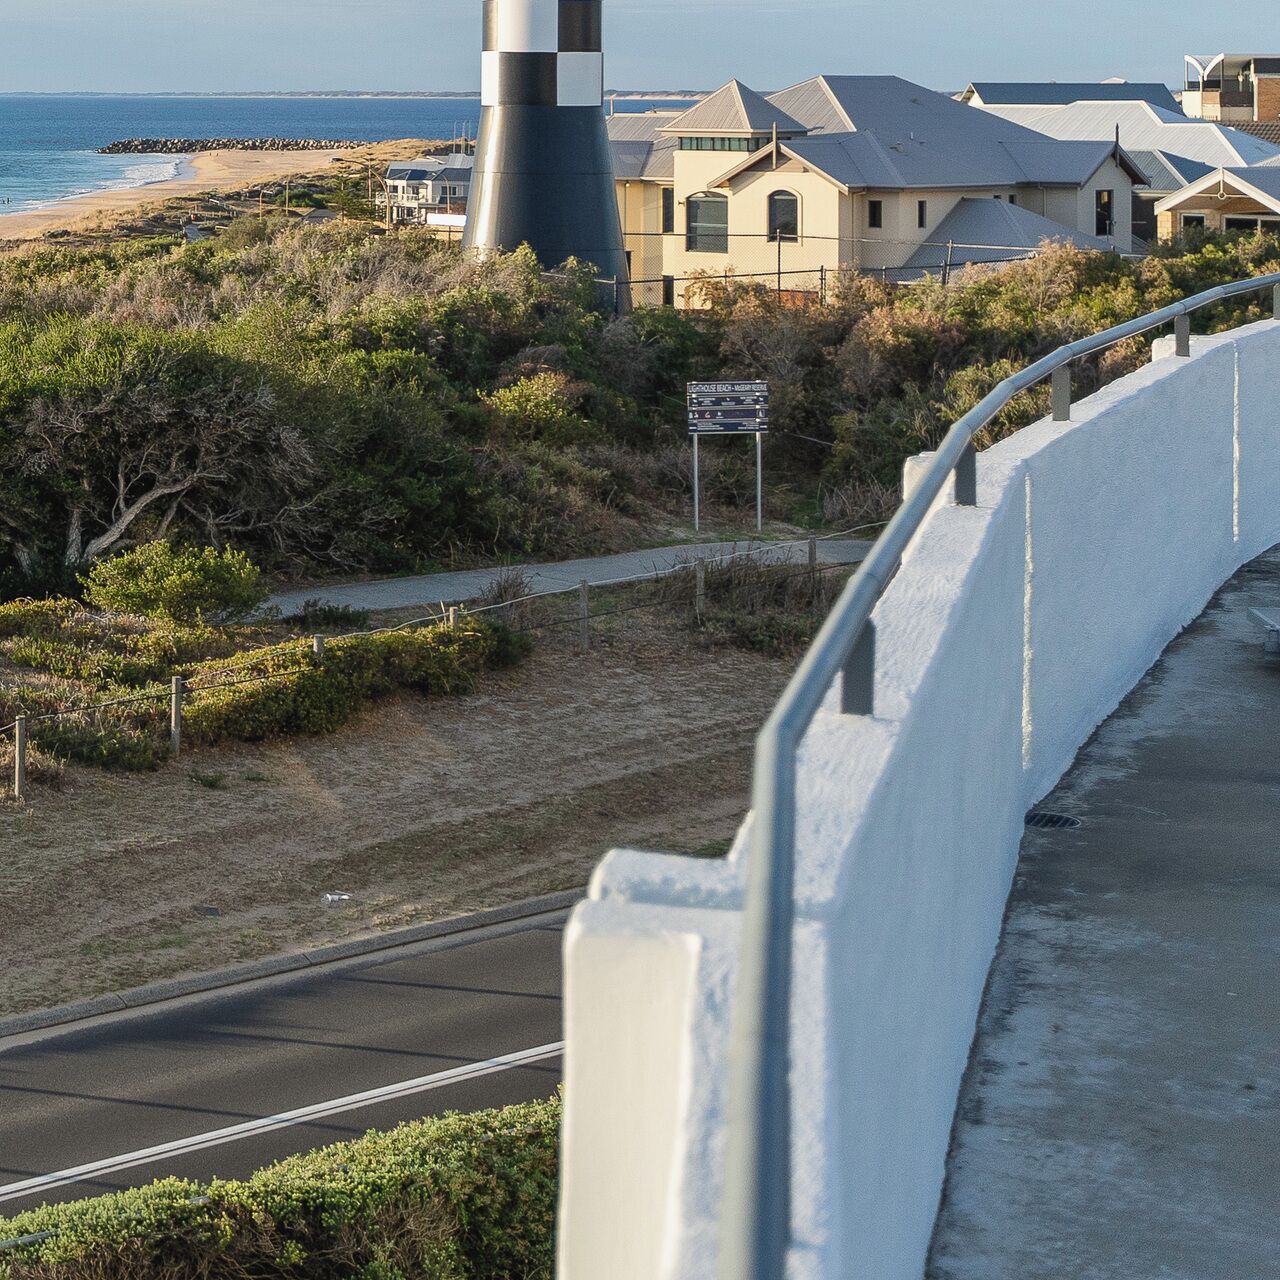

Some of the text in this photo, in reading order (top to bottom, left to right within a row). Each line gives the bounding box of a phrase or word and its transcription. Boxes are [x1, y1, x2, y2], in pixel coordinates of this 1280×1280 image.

[689, 384, 716, 393] LIGHTHOUSE
[717, 384, 731, 392] BEACH
[752, 383, 767, 391] RESERVE
